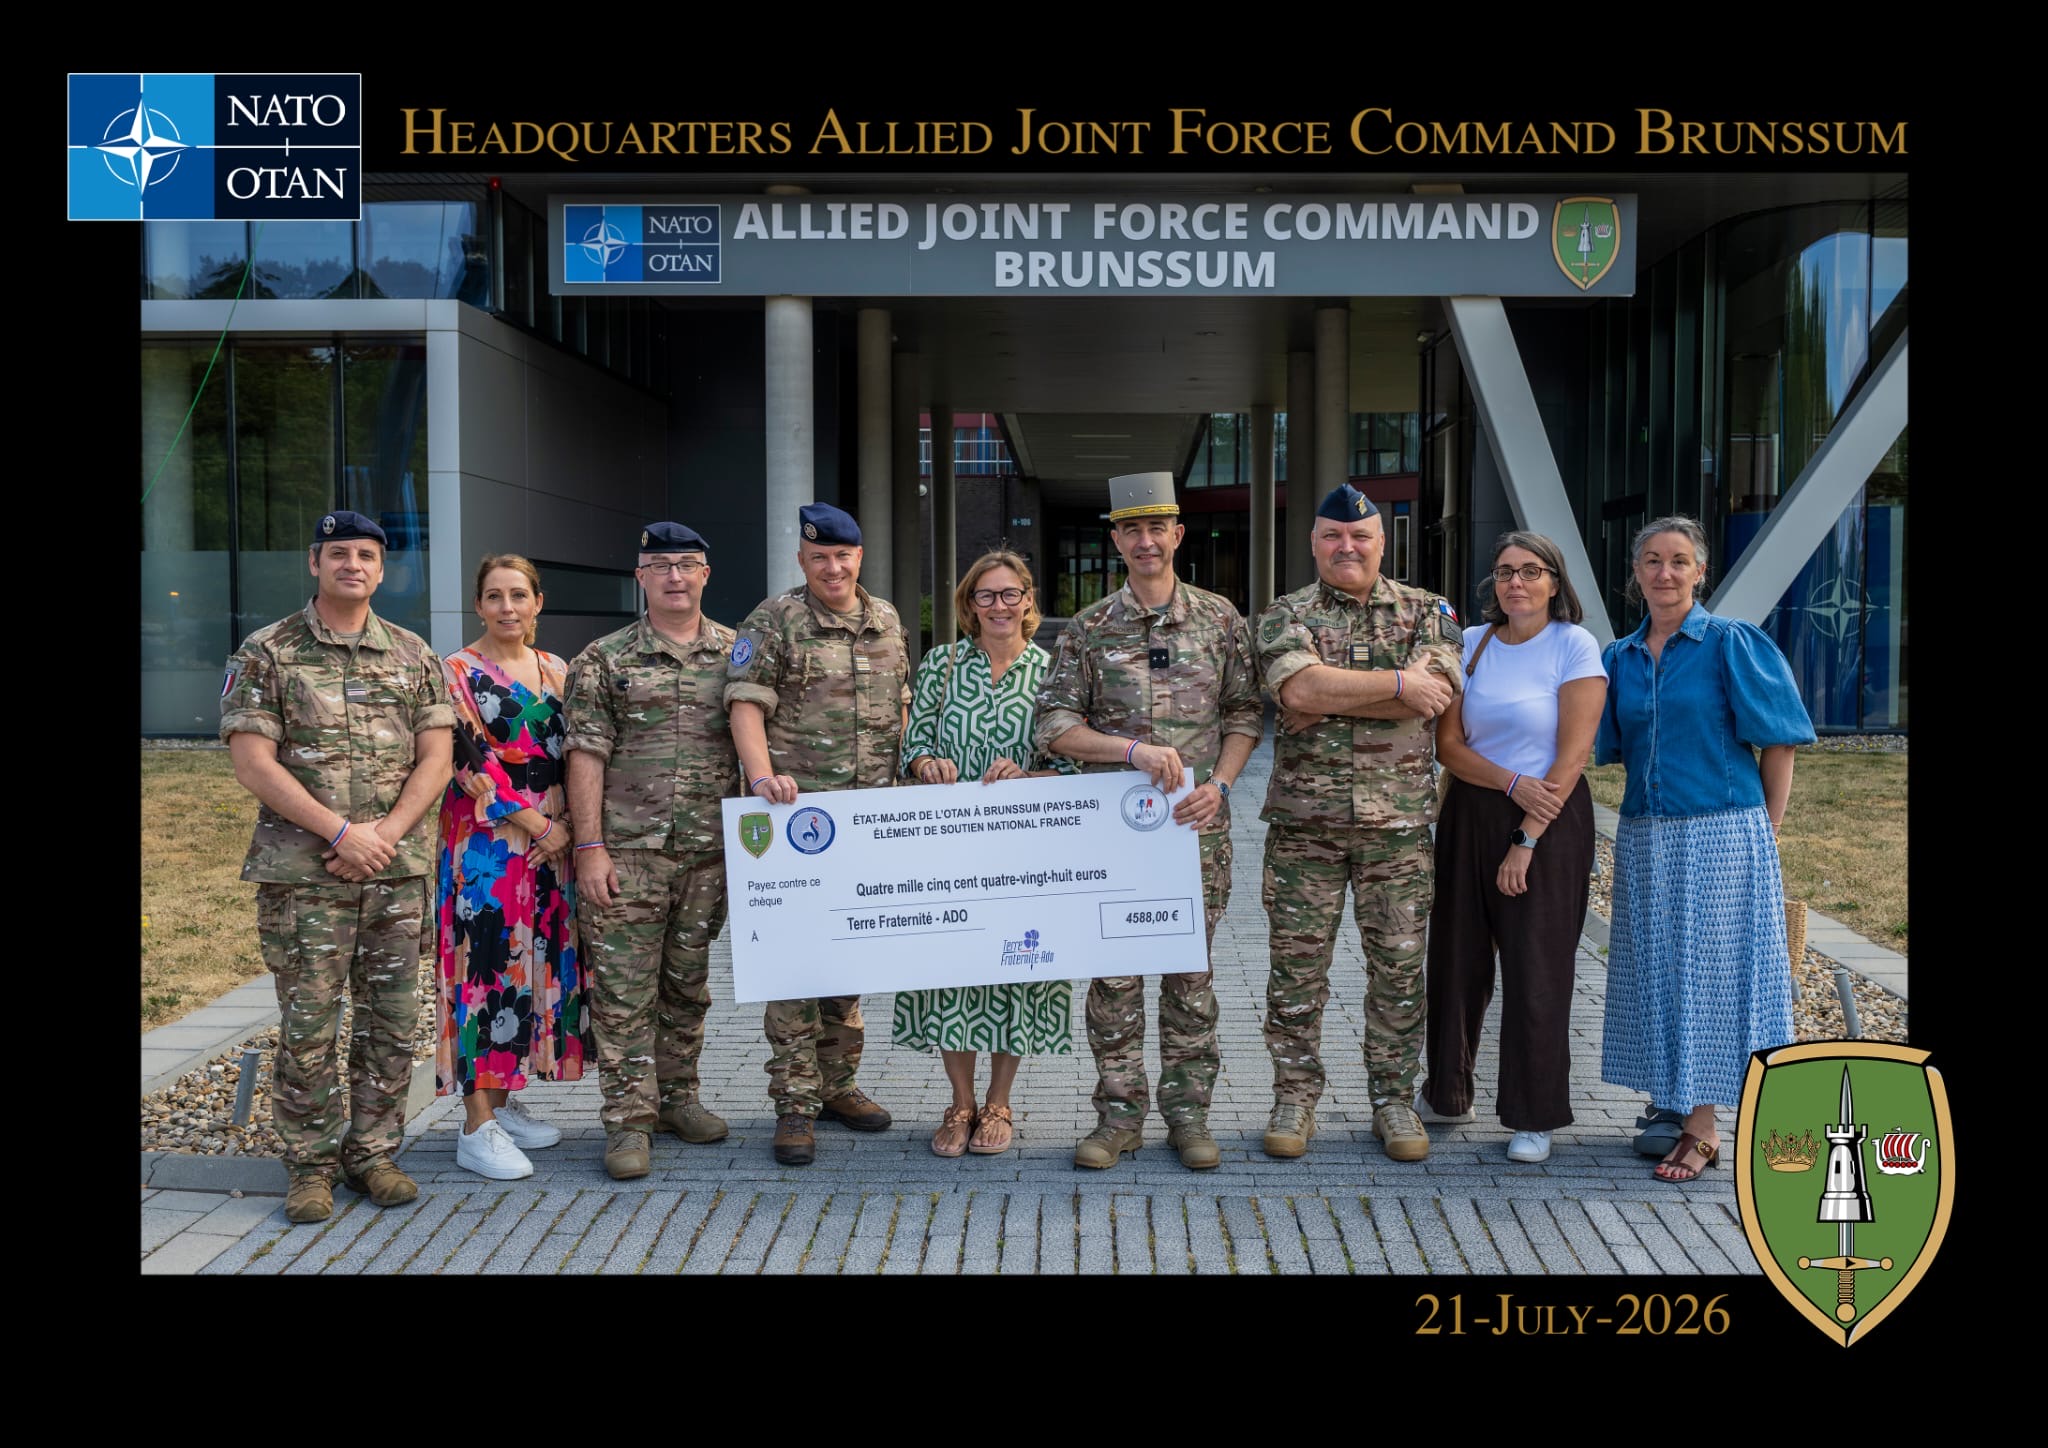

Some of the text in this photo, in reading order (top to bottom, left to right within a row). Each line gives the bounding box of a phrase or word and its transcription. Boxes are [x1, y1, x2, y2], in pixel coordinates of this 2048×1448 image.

[649, 216, 713, 234] NATO
[733, 203, 1539, 249] ALLIED JOINT FORCE COMMAND
[648, 254, 713, 272] OTAN
[995, 250, 1276, 288] BRUNSSUM
[853, 799, 1100, 825] ÉTAT-MAJOR DE L'OTAN À BRUNSSUM (PAYS-BAS)
[873, 816, 1081, 839] ÉLÉMENT DE SOUTIEN NATIONAL FRANCE
[748, 878, 821, 892] Payez contre ce
[856, 868, 1108, 897] Quatre mille cinq cent quatre-vingt-huit euros
[749, 897, 783, 908] chèque
[847, 916, 876, 931] Terre
[879, 911, 933, 929] Fraternité
[942, 909, 968, 924] ADO
[1126, 910, 1179, 924] 4588,00 €
[1003, 939, 1023, 951] Terre
